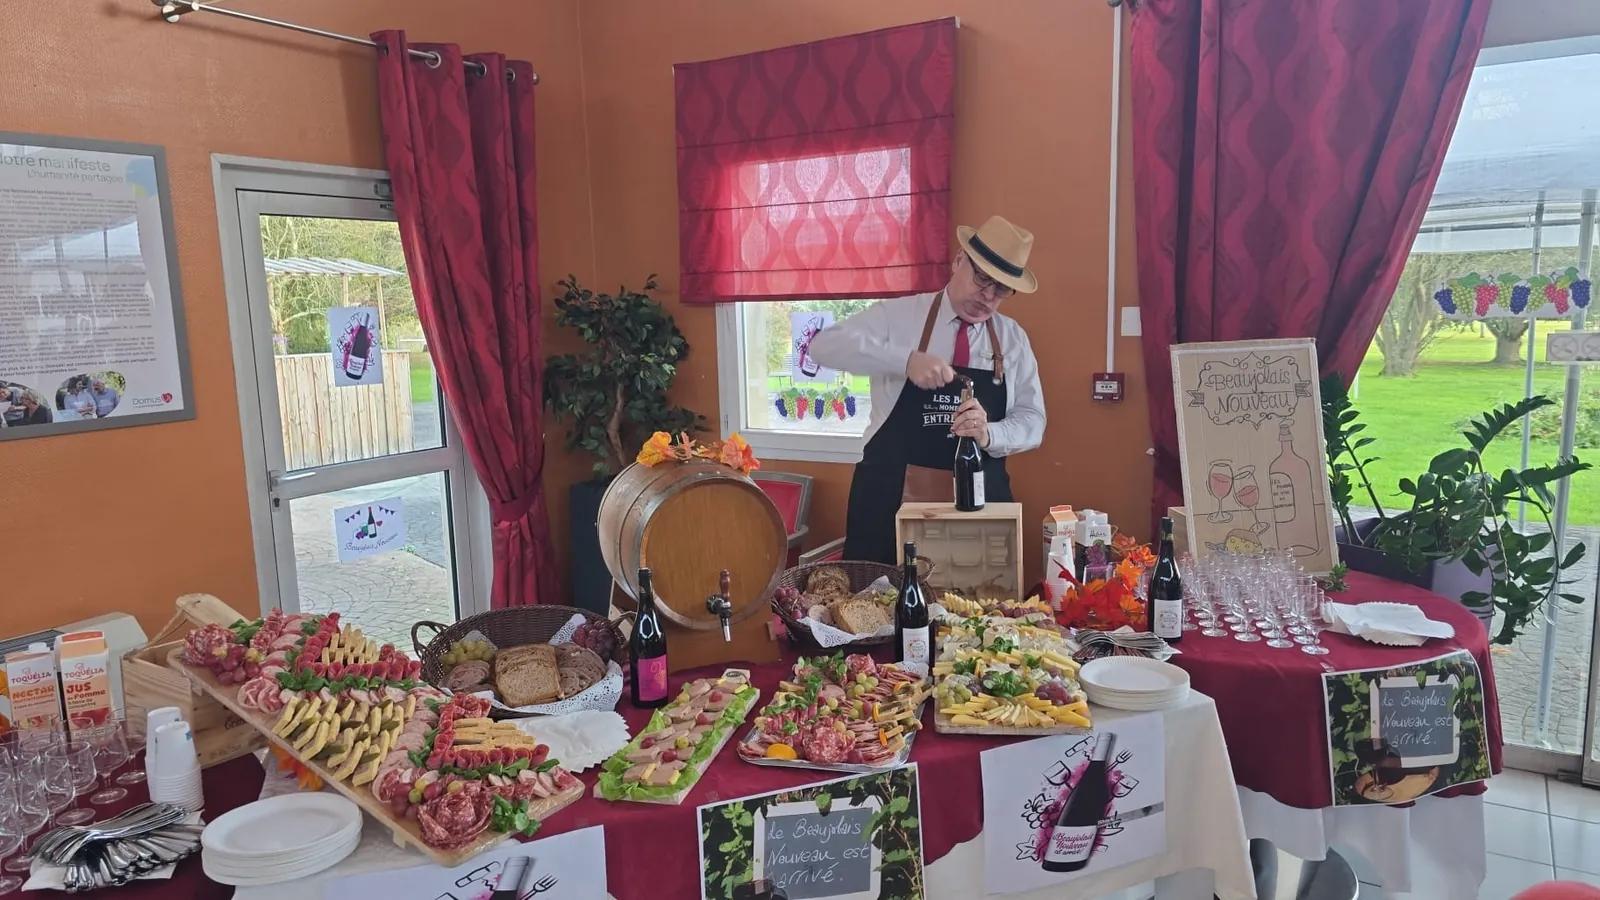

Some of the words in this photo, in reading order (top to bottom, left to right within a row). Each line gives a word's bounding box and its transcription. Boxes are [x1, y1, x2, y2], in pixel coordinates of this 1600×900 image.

[38, 157, 112, 172] manifeste
[1204, 365, 1291, 394] Beaujolais
[933, 394, 950, 403] LES
[1214, 393, 1292, 415] Nouveau
[11, 671, 52, 684] TOQUÉLIA
[64, 667, 105, 679] TOQUÉLIA
[12, 685, 55, 700] NECTAR
[66, 682, 92, 694] JUS
[1382, 711, 1430, 728] Nouveau
[1434, 713, 1453, 727] est
[792, 815, 861, 844] Beaujolais
[767, 843, 836, 867] Nouveau
[843, 842, 870, 858] est
